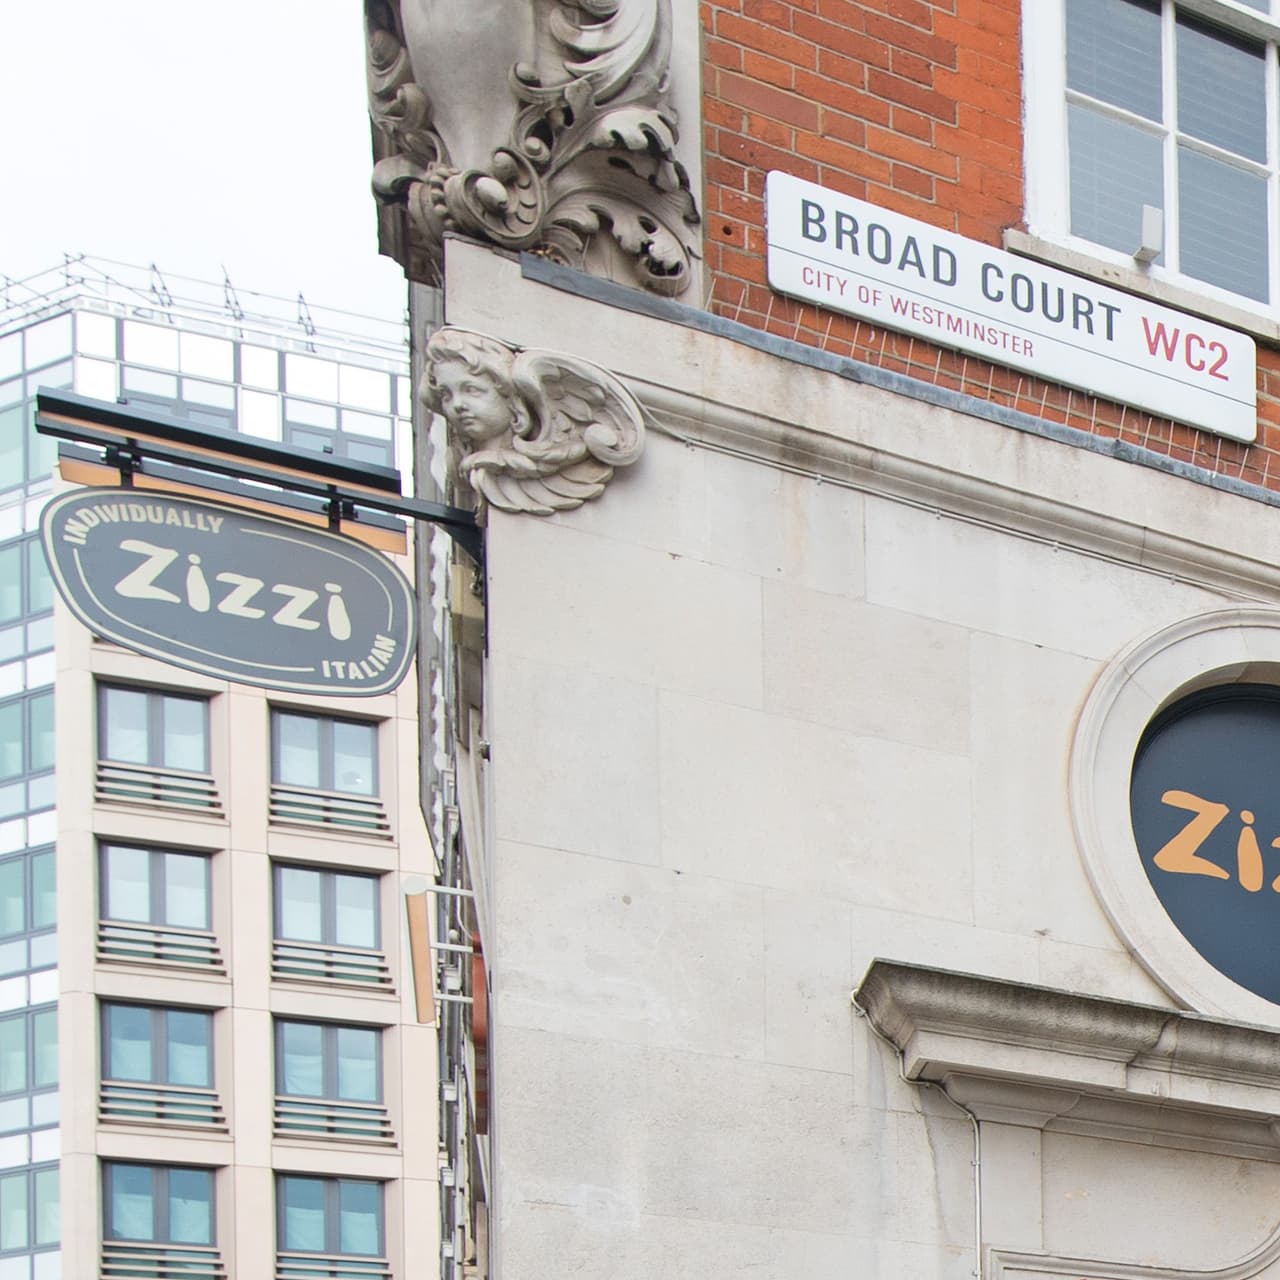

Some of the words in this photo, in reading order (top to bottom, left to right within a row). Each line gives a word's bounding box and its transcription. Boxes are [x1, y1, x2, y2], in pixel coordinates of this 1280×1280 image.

[800, 198, 957, 287] BROAD
[981, 262, 1121, 341] COURT
[1142, 316, 1230, 381] WC2
[802, 265, 848, 296] CITY
[857, 285, 882, 307] OF
[889, 294, 1034, 358] WESTMINSTER
[63, 502, 225, 546] INDIVIDUALLY
[115, 538, 352, 641] Zizzi
[321, 633, 397, 680] ITALIAN
